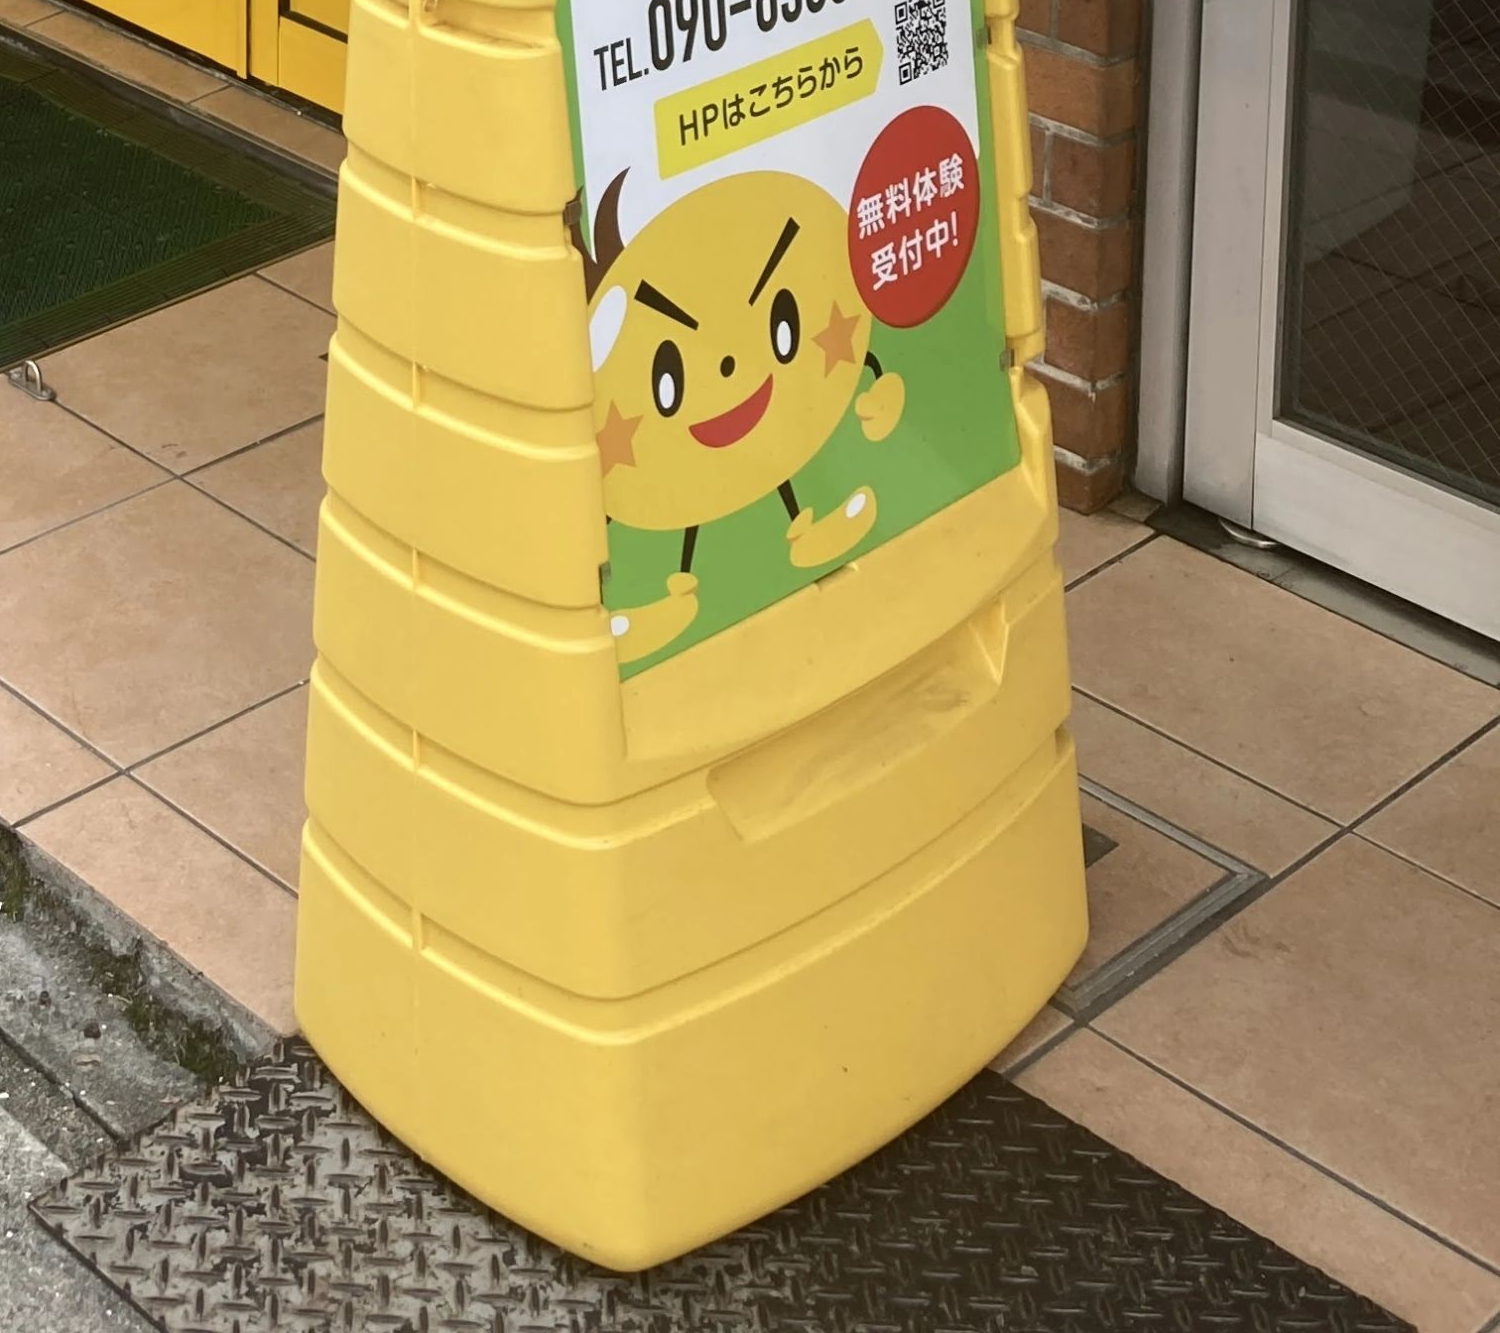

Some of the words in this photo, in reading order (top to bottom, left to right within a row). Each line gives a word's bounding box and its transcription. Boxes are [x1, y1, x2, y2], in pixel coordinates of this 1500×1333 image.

[679, 46, 864, 145] HPはこちらから
[857, 153, 964, 239] 無料体験
[871, 211, 958, 291] 受付中!
